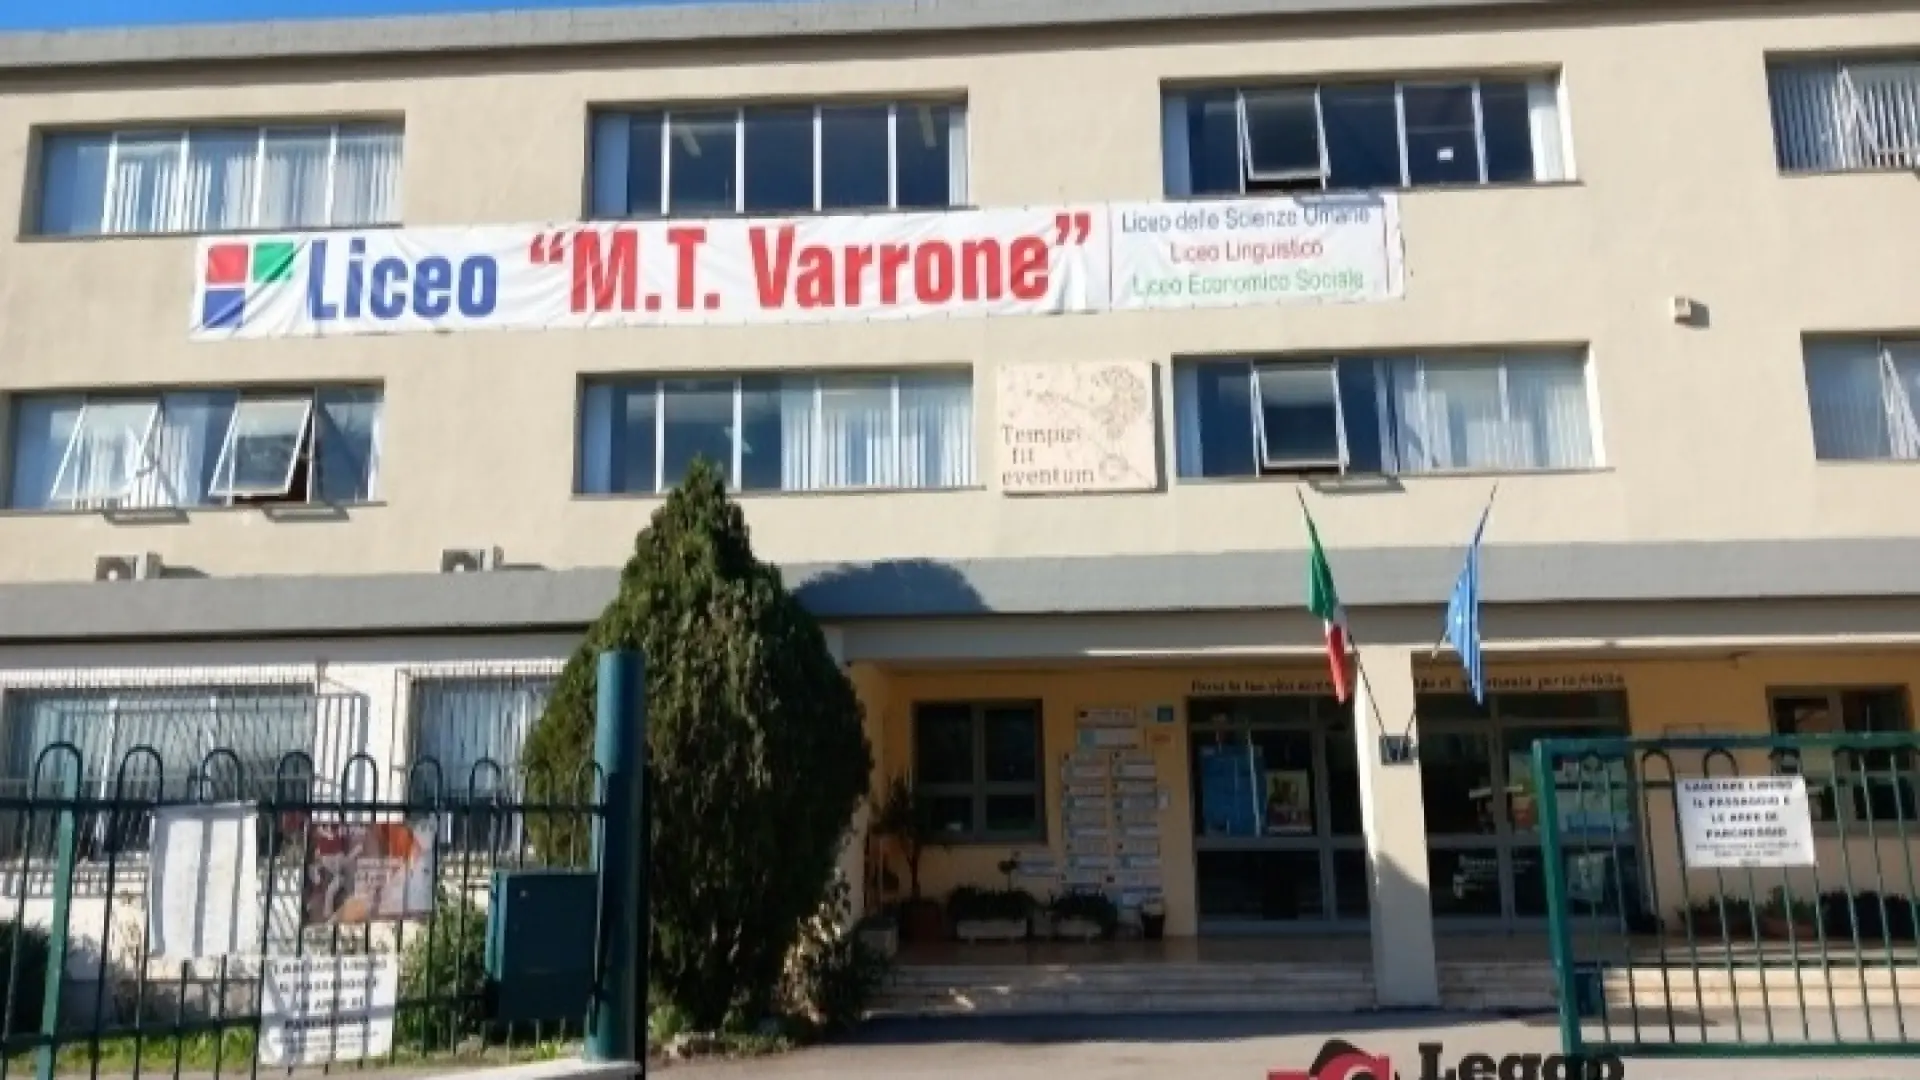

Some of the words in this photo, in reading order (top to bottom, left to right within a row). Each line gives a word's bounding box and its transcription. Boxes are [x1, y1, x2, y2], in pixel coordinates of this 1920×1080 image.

[1122, 211, 1171, 233] Liceo
[1225, 207, 1297, 230] Scienze
[1170, 241, 1220, 265] Liceo
[1226, 236, 1324, 264] Linguistico
[308, 238, 498, 320] Liceo
[1132, 274, 1182, 296] Liceo
[1188, 271, 1291, 295] Economico
[1295, 267, 1364, 291] Sociale
